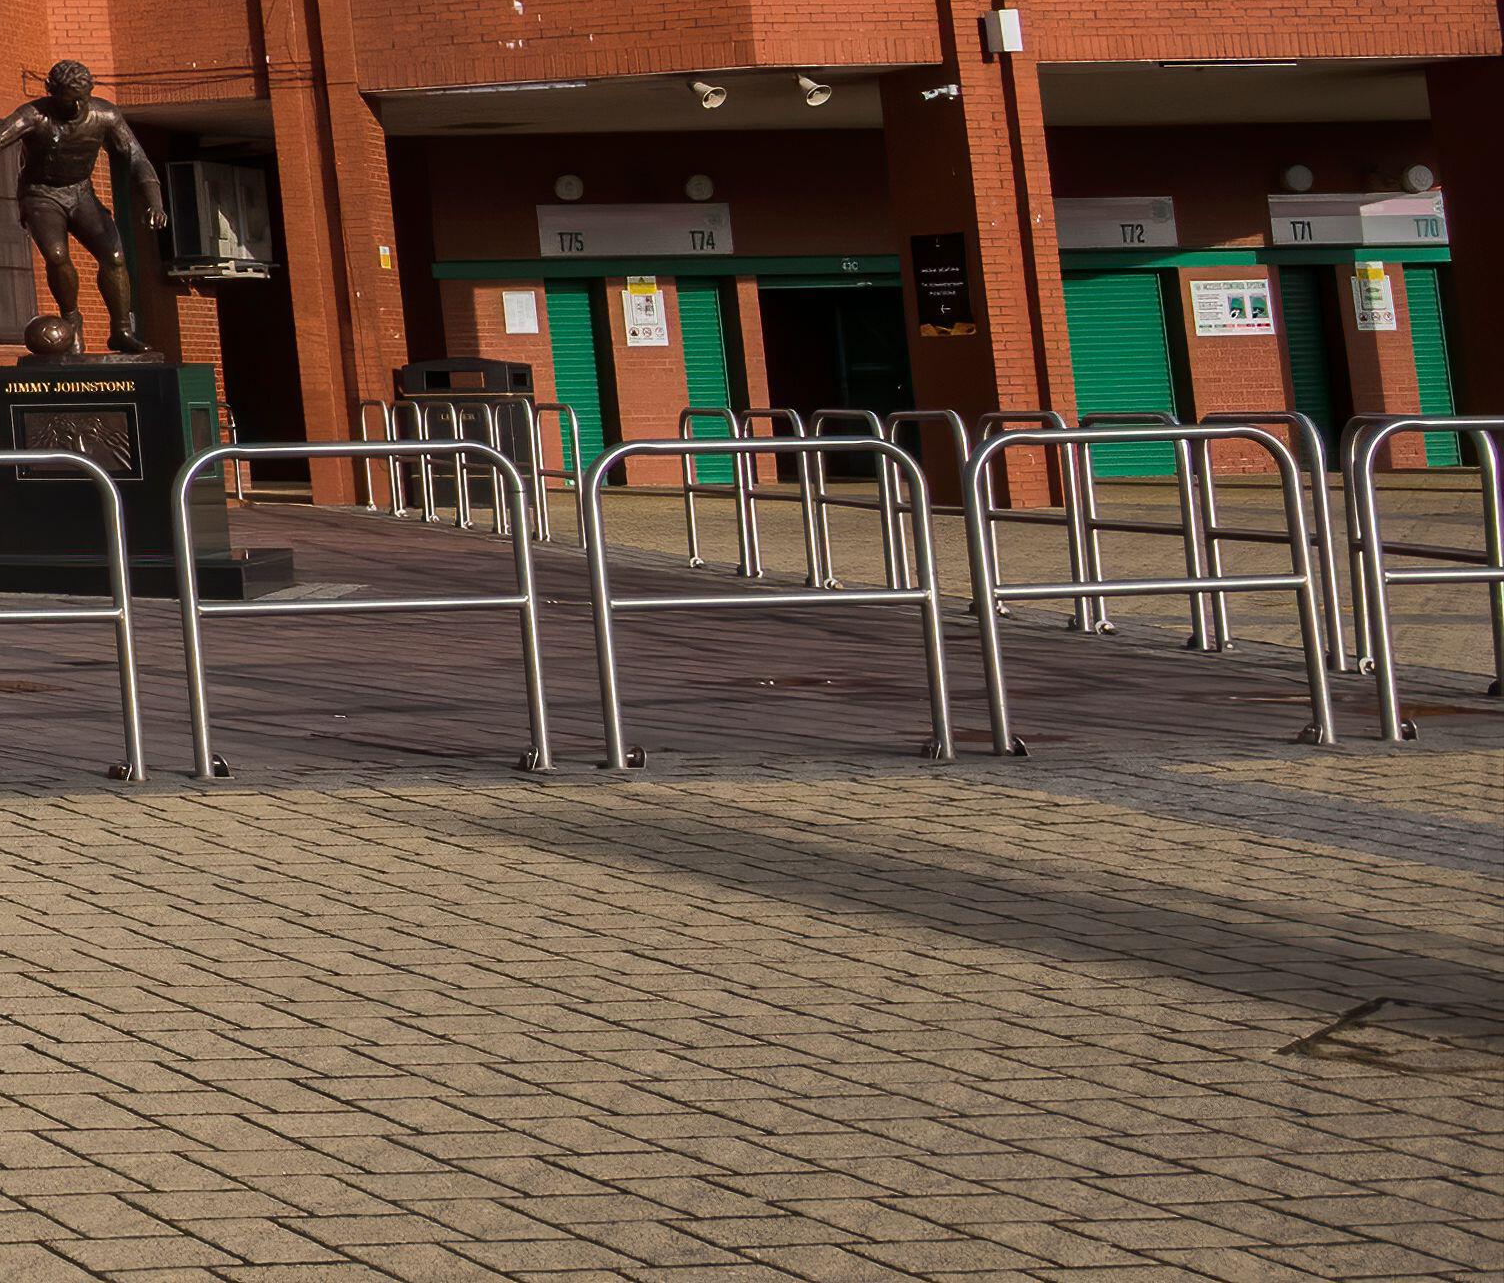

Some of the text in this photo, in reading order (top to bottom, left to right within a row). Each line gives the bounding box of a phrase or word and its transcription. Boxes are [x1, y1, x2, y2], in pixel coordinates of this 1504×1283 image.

[690, 230, 716, 250] T74
[1119, 223, 1146, 243] T72
[1290, 220, 1313, 241] T71
[557, 232, 584, 252] T75
[5, 381, 136, 393] JIMMY JOHNSTONE
